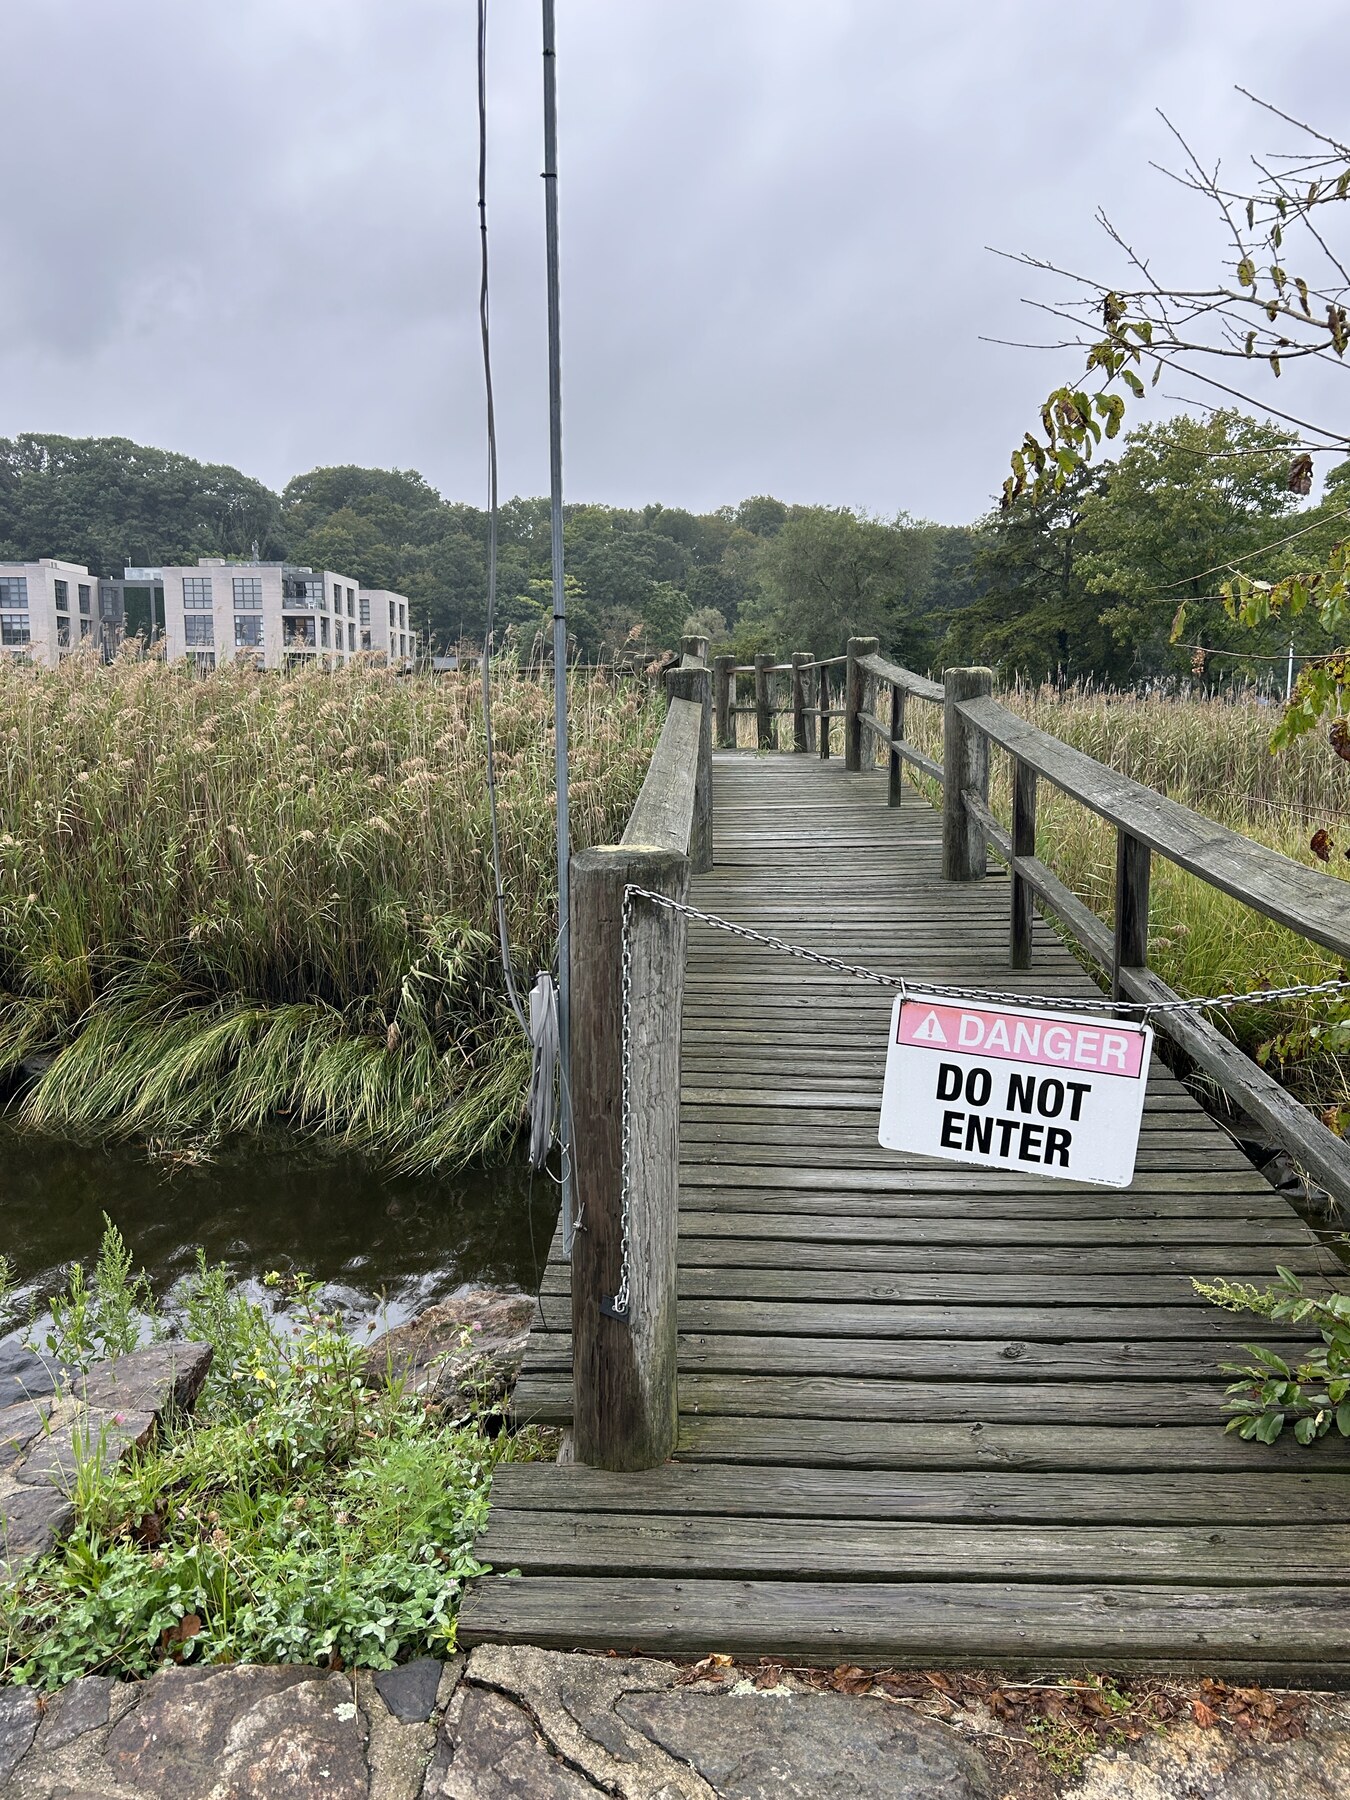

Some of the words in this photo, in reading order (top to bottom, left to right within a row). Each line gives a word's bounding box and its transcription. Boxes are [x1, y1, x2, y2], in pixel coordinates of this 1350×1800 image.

[957, 1014, 1128, 1069] DANGER
[936, 1062, 992, 1107] DO
[1006, 1073, 1092, 1122] NOT
[940, 1110, 1073, 1168] ENTER
